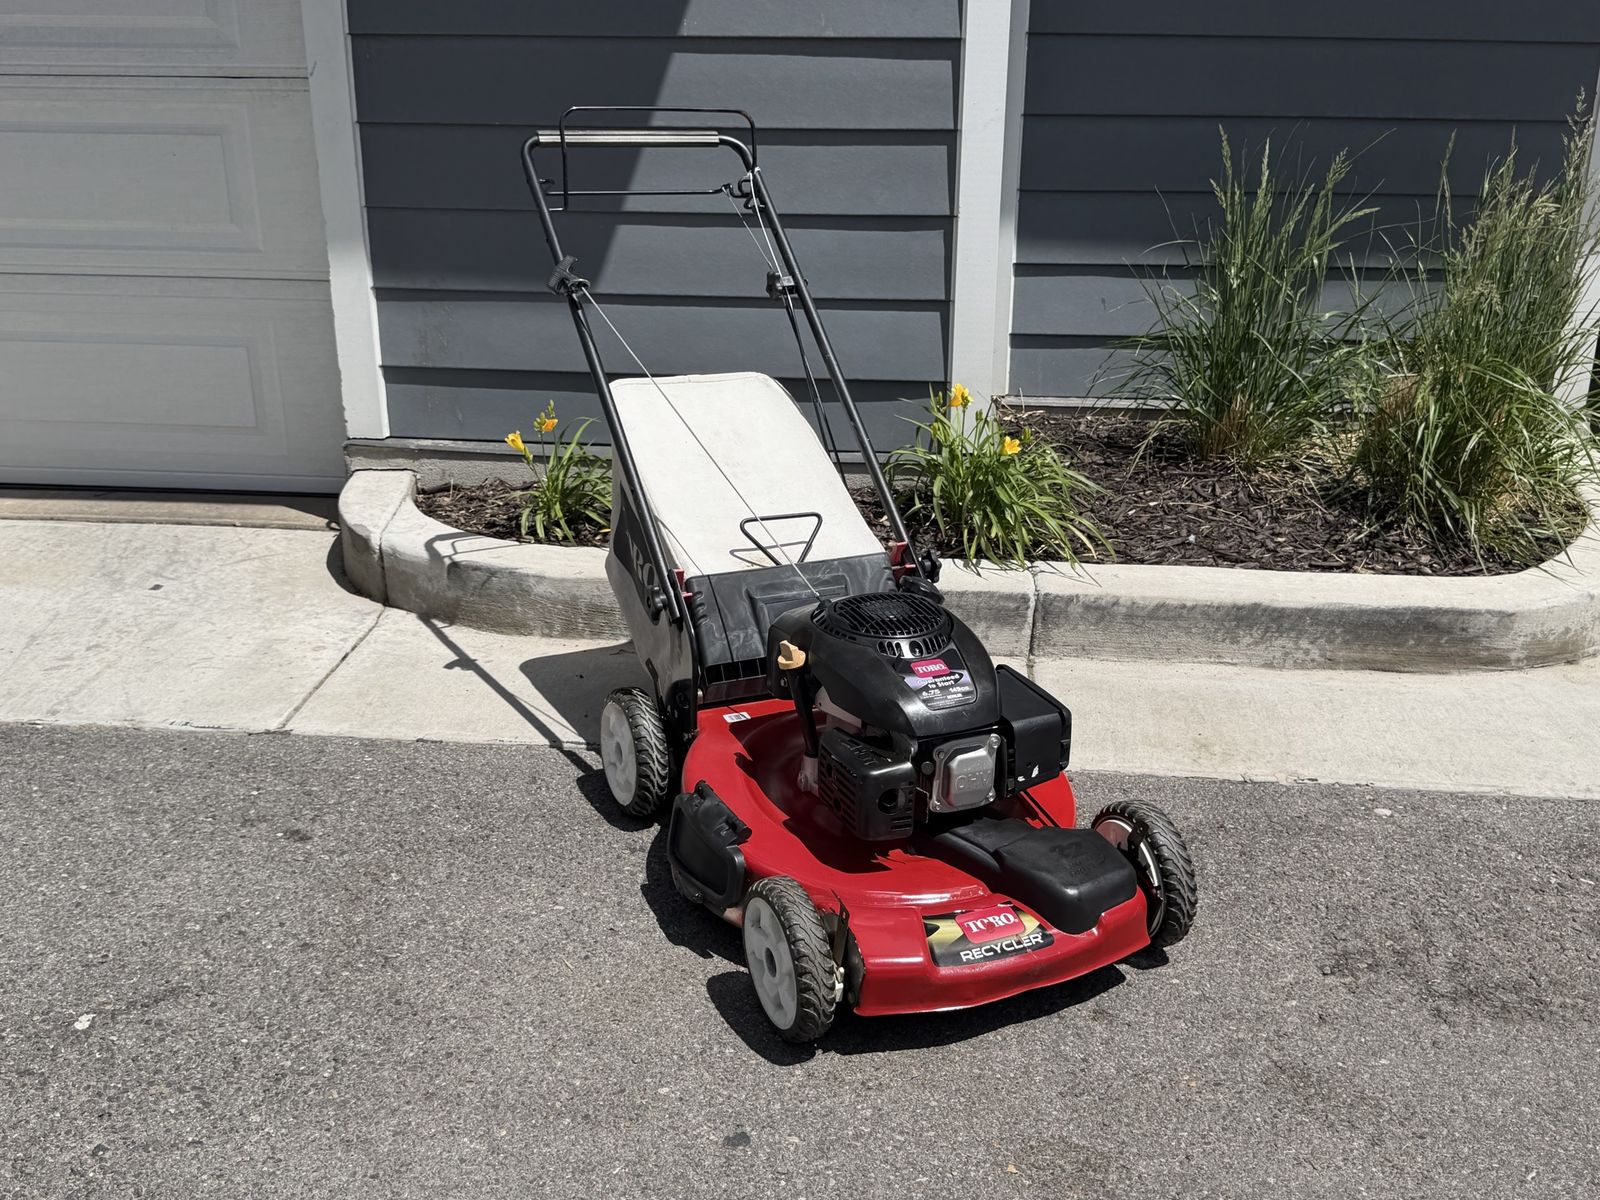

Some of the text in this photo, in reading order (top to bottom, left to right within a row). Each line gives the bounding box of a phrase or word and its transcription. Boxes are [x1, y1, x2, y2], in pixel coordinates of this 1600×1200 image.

[915, 663, 946, 674] TORO
[937, 680, 955, 688] Start
[922, 689, 941, 697] 6.75
[964, 912, 1015, 933] TORO
[960, 933, 1044, 962] RECYCLER
